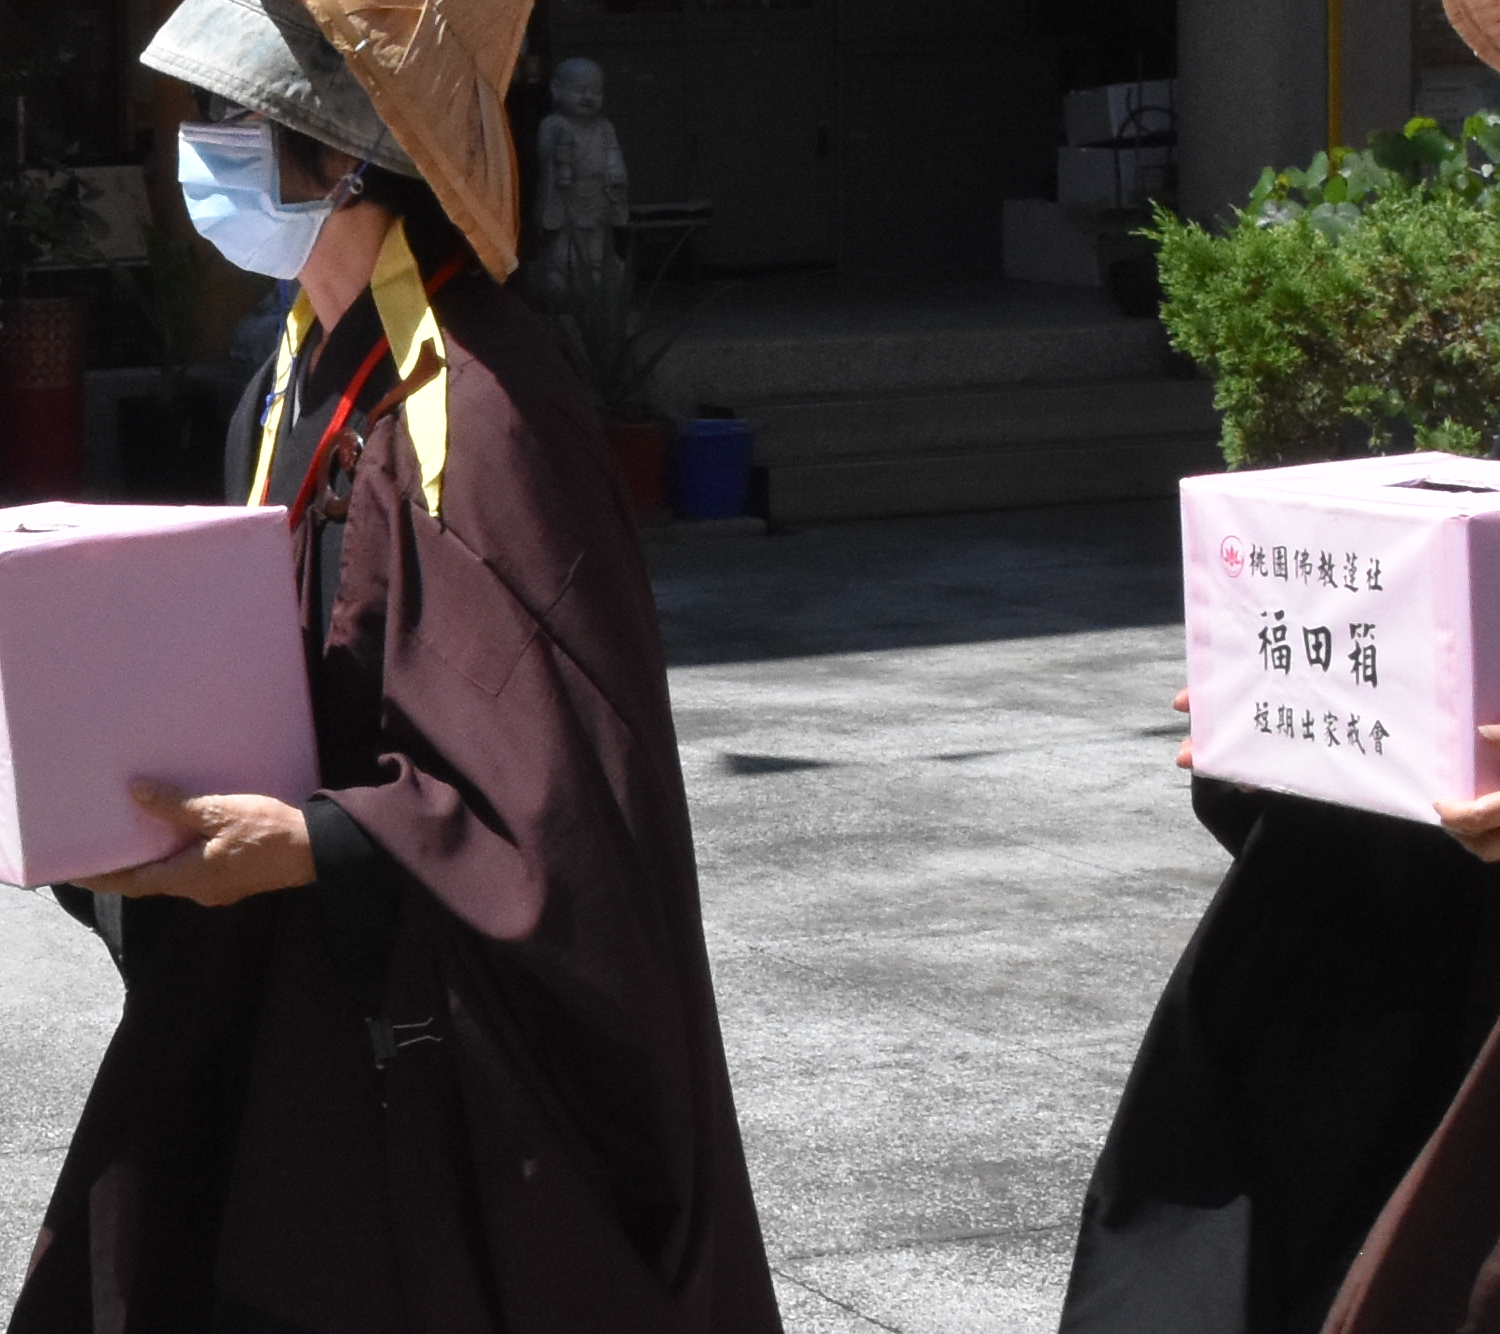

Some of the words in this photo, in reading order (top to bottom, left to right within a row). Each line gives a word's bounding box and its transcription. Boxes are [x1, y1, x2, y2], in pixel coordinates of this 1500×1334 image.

[1250, 543, 1384, 593] 桃園佛教蓮社
[1257, 609, 1379, 689] 福田箱
[1253, 700, 1391, 757] 短期出家戒會
